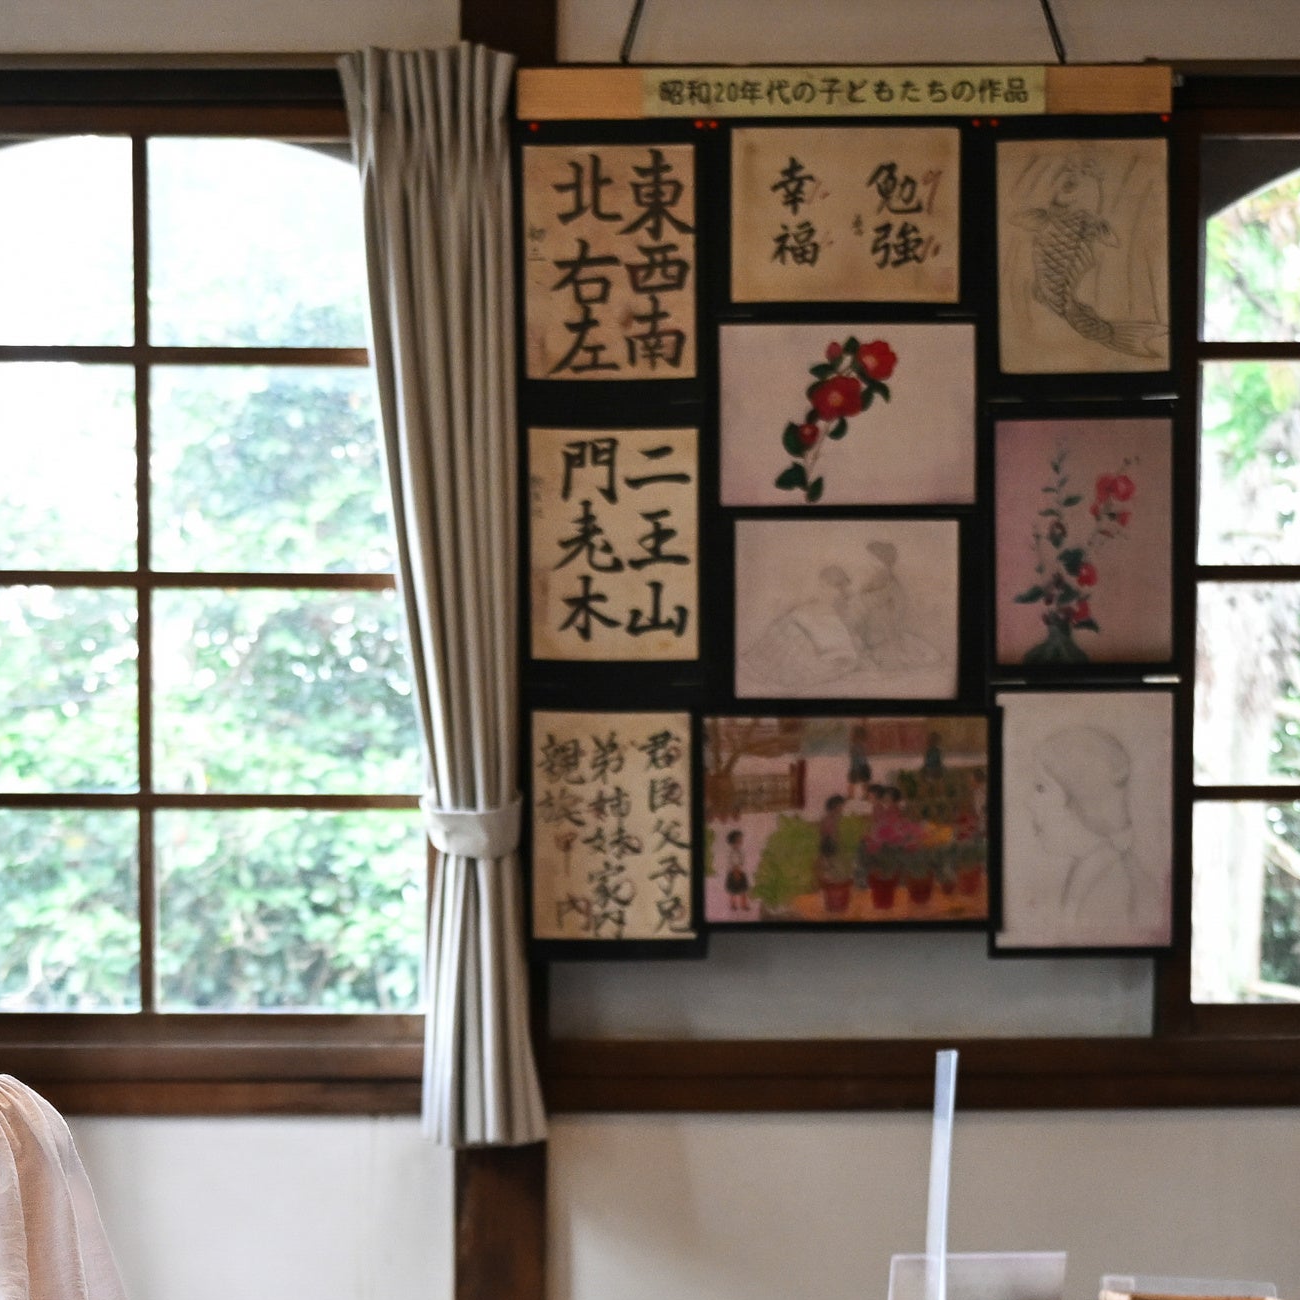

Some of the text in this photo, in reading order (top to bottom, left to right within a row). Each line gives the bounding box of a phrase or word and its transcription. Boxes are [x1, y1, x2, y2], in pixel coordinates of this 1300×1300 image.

[657, 76, 1030, 106] 昭和20年代の子どもたちの作品
[548, 154, 623, 375] 北右左
[618, 148, 696, 369] 東西南
[770, 156, 822, 268] 幸福
[866, 161, 926, 270] 勉強
[624, 445, 691, 637] 二王山
